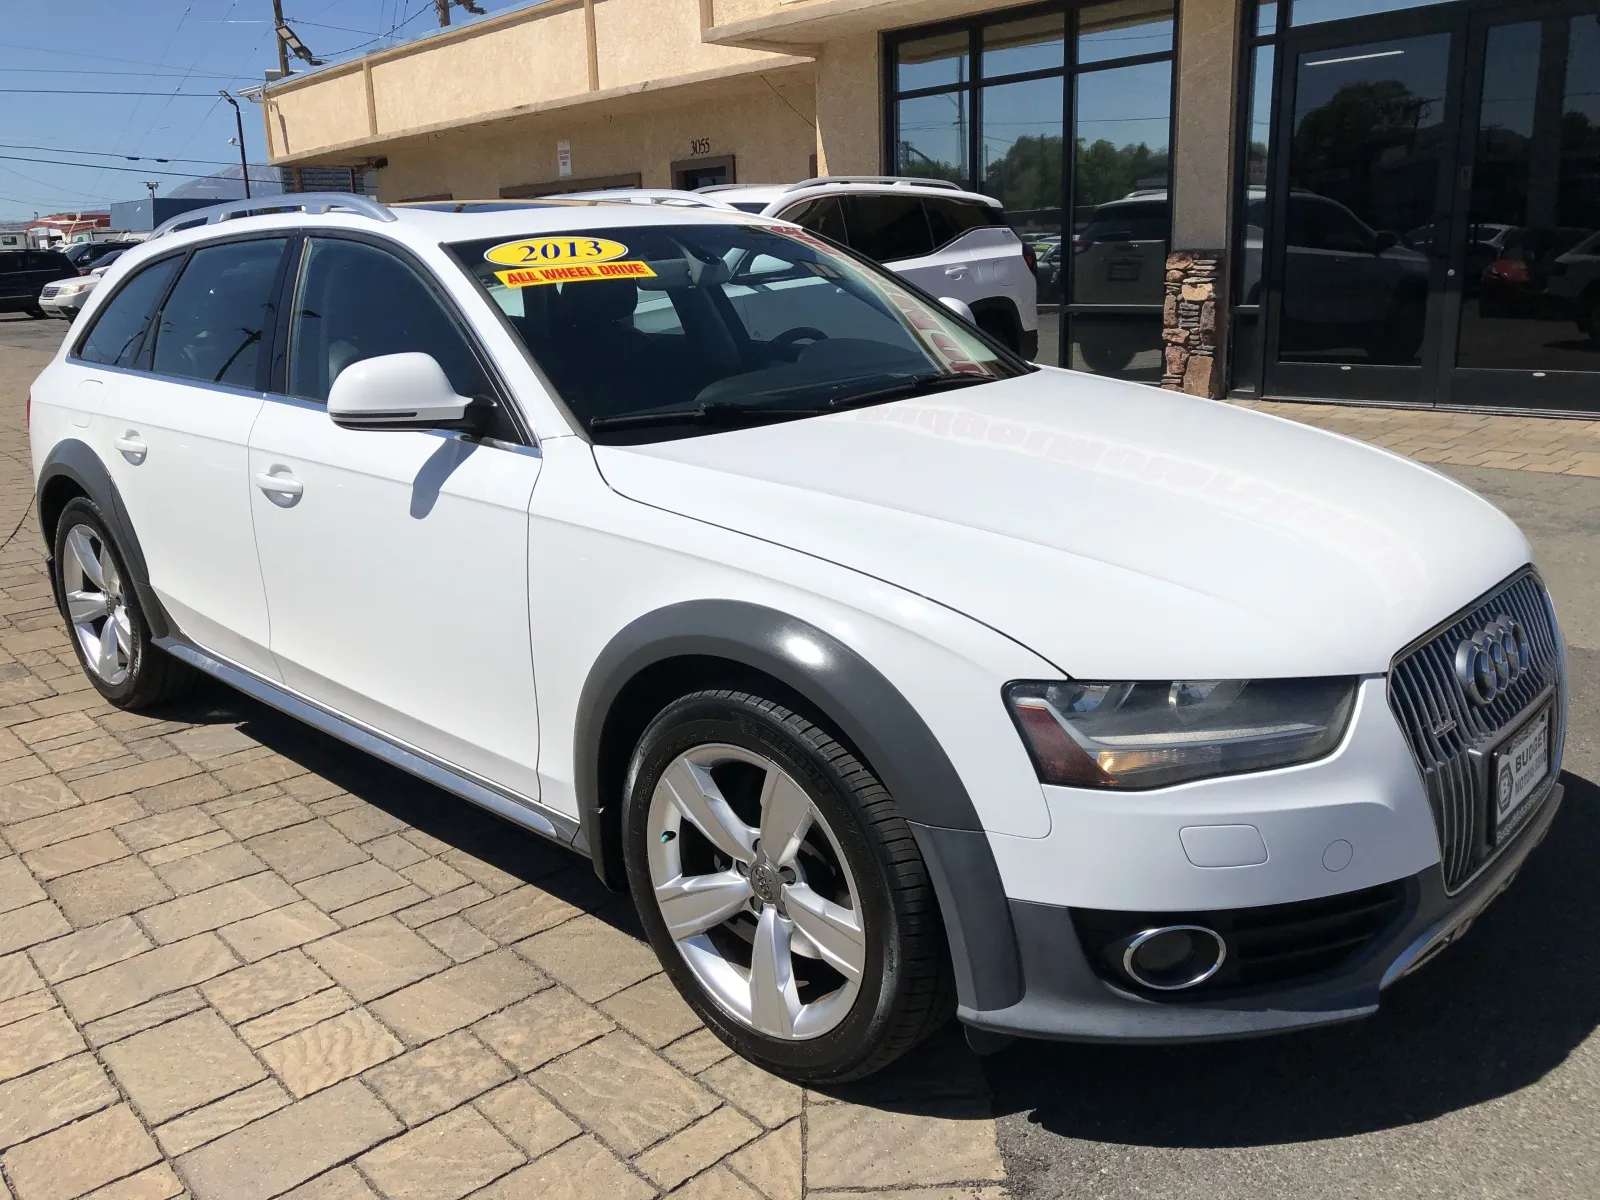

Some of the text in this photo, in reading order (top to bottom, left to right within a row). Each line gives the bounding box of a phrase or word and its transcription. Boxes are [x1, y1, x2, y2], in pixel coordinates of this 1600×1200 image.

[690, 137, 710, 156] 3055
[517, 240, 603, 263] 2013
[506, 263, 647, 286] ALL WHEEL DRIVE
[1515, 726, 1547, 773] BUDGET
